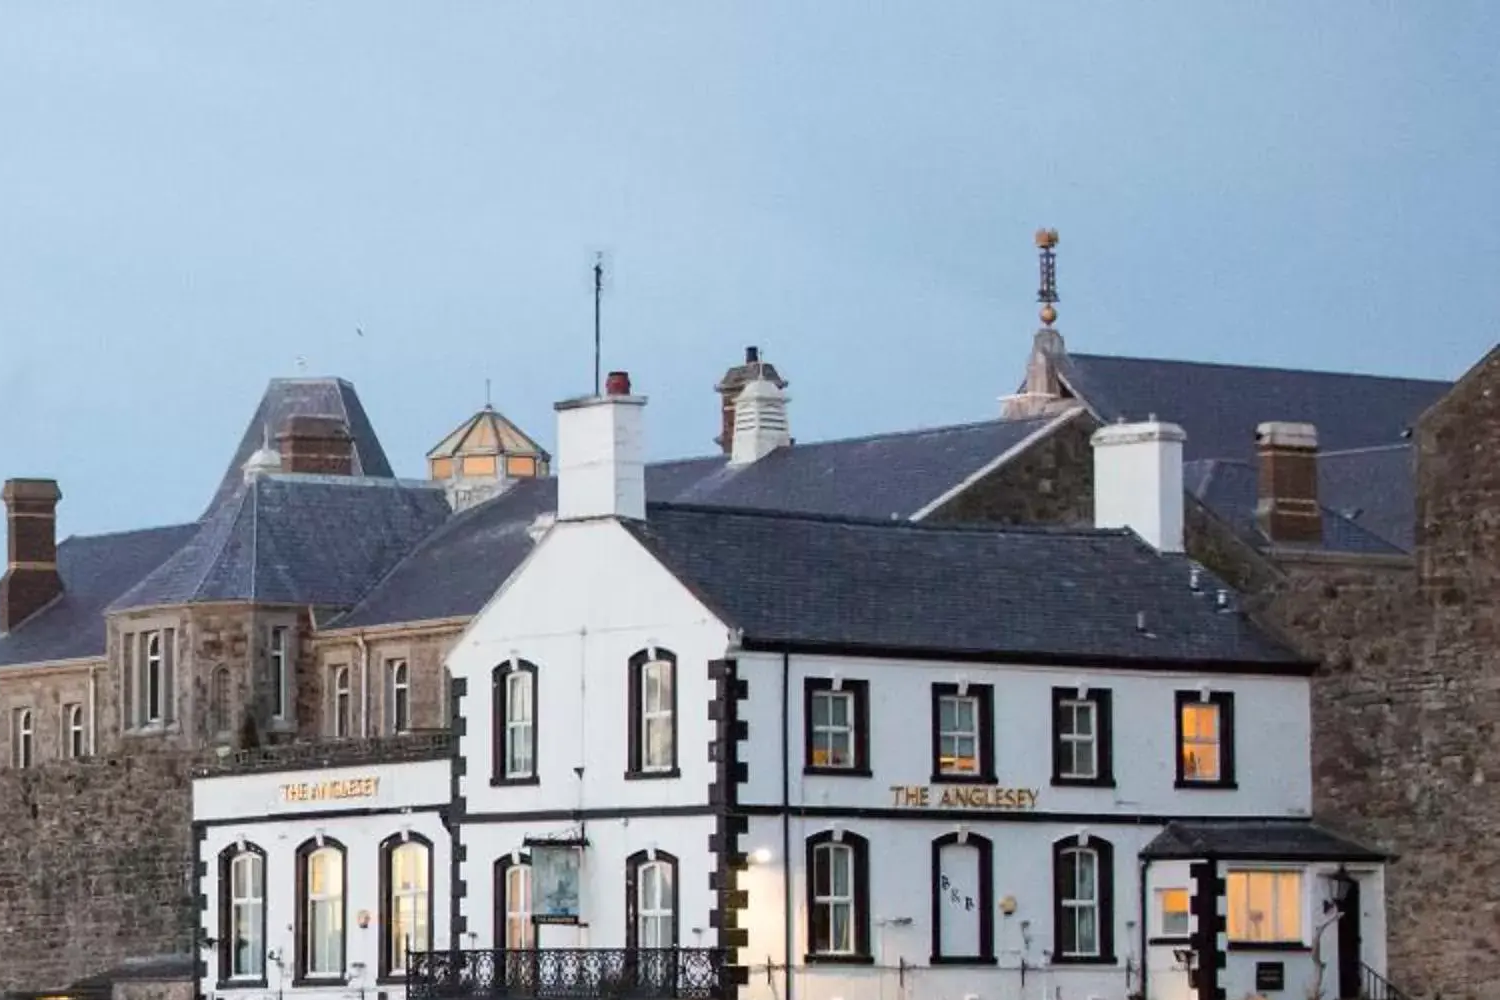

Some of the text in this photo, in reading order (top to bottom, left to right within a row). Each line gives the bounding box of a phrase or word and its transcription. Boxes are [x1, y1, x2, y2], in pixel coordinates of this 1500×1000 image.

[280, 783, 308, 801] THE
[890, 785, 1039, 808] THE ANGLESEY
